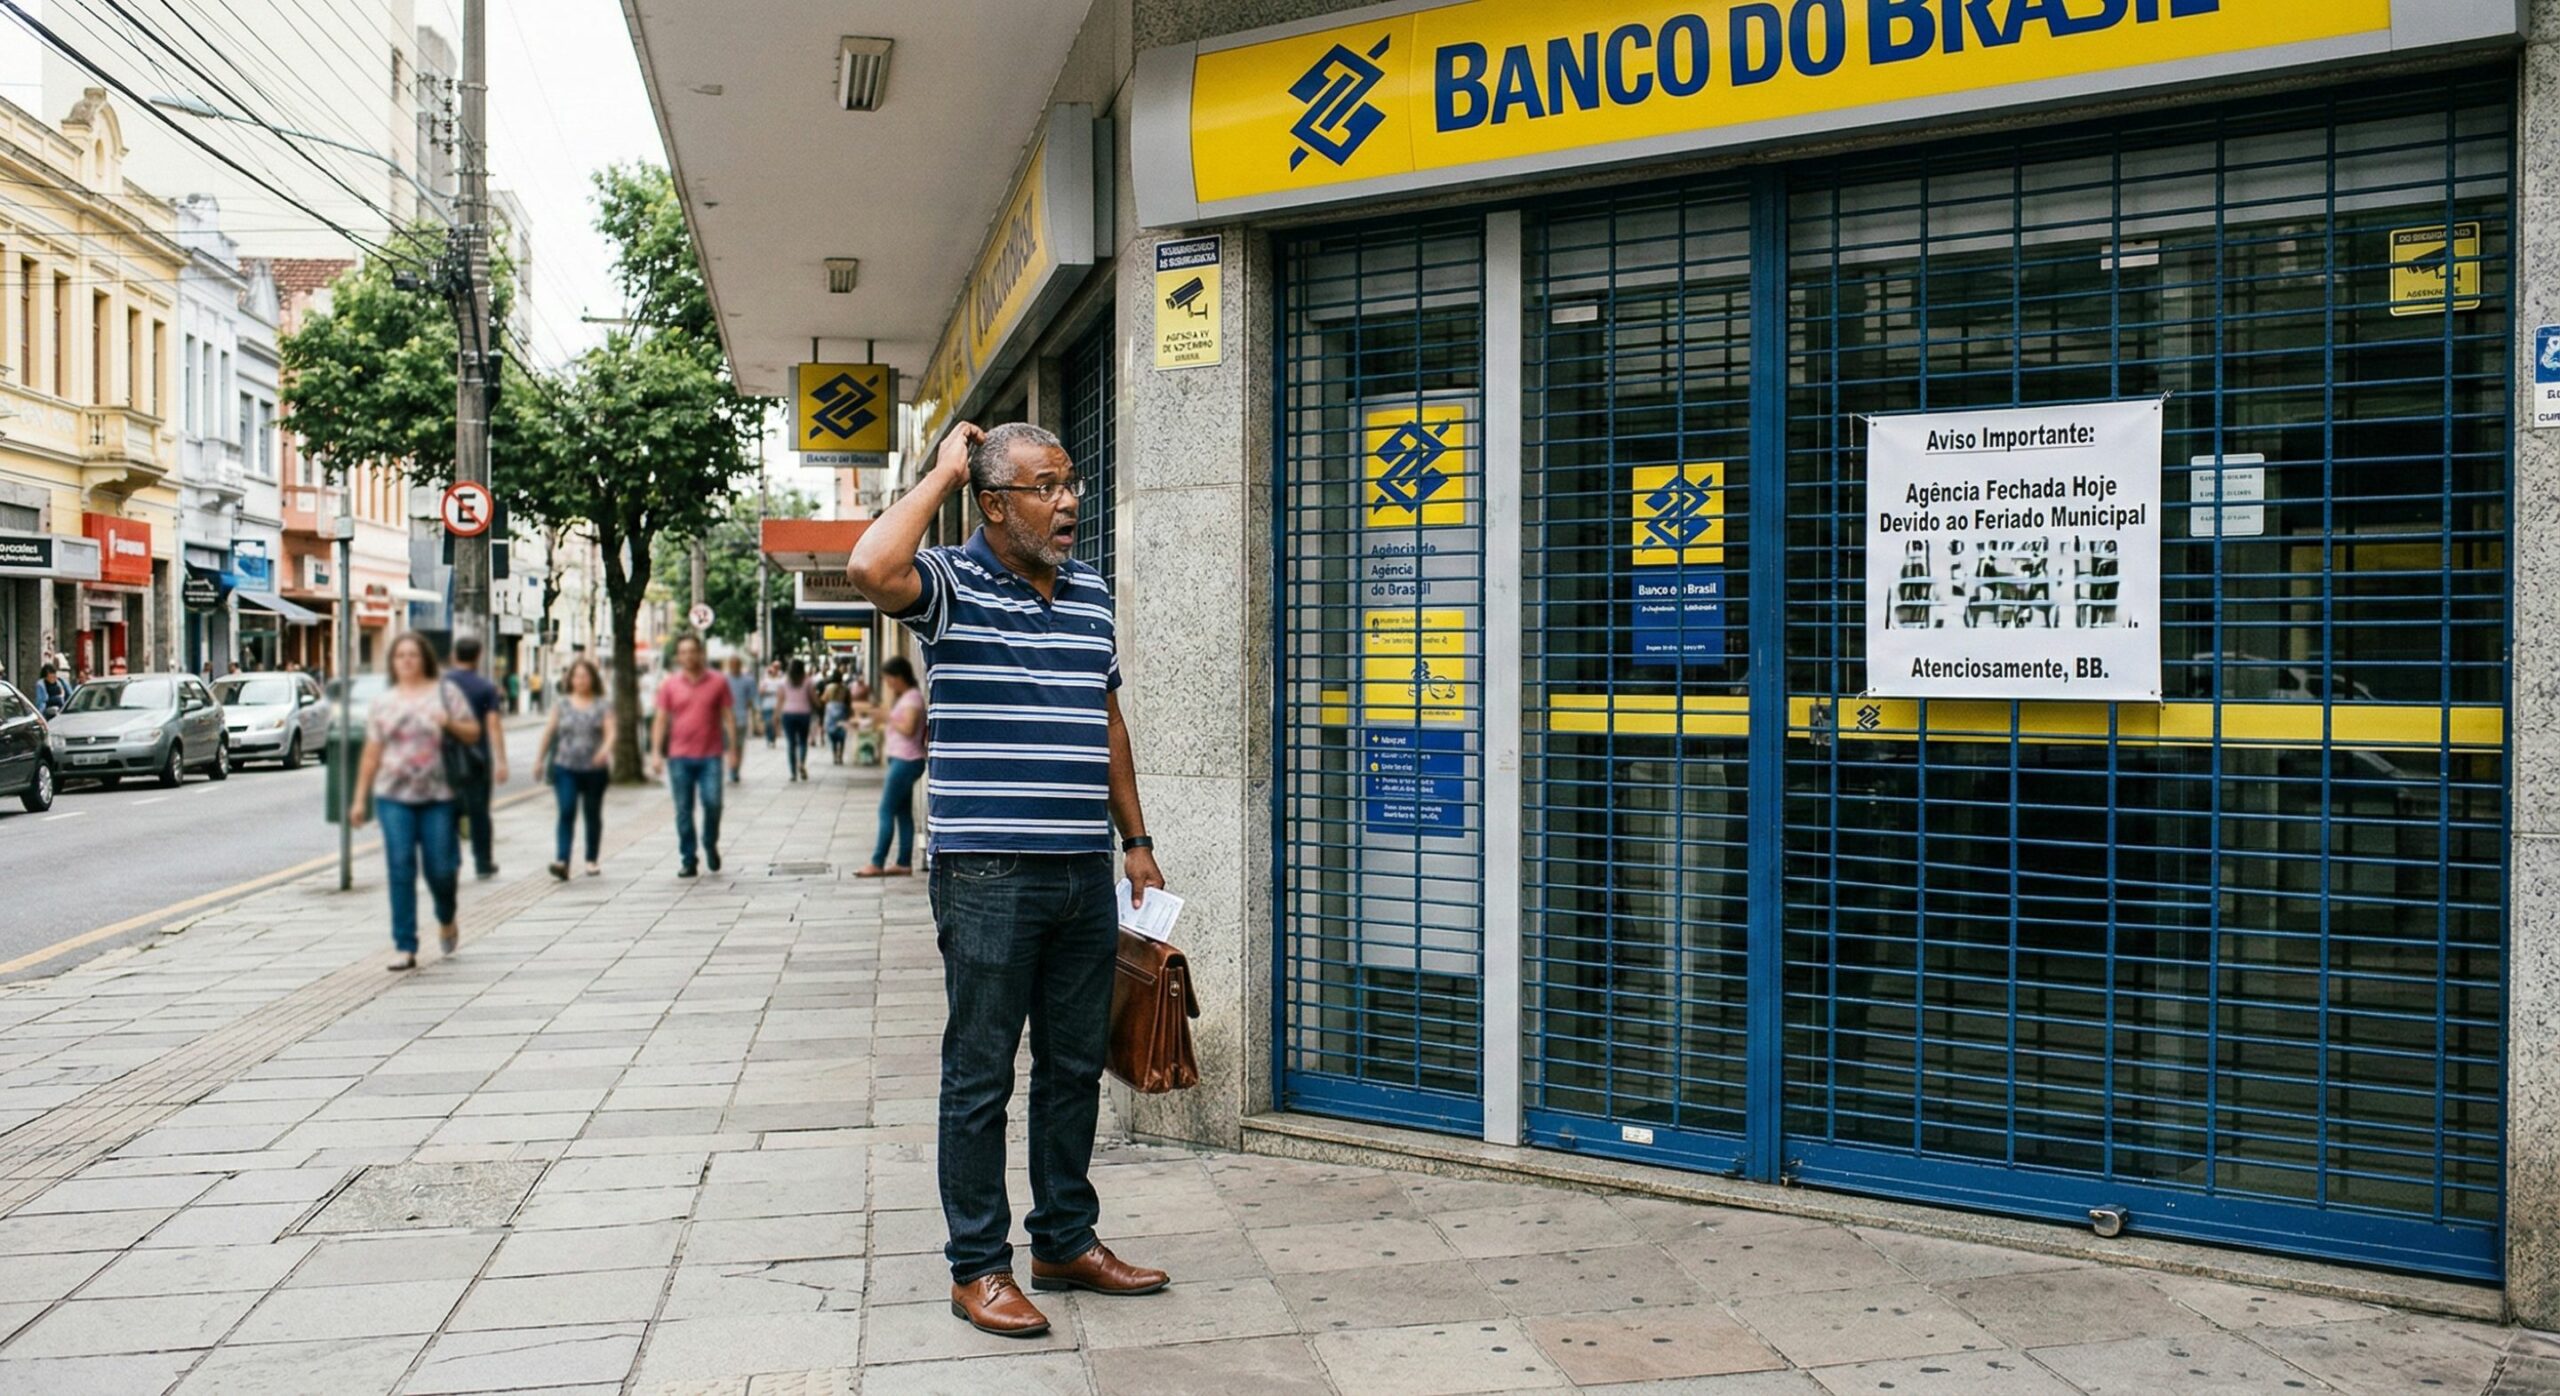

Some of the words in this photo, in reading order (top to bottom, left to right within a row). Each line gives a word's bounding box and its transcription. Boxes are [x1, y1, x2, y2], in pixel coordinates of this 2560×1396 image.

[1434, 13, 1711, 133] BANCO
[1729, 0, 1847, 87] DO
[1926, 429, 1976, 451] Aviso
[1983, 422, 2095, 451] Importante:
[1905, 480, 1980, 508] Agência
[1986, 477, 2066, 500] Fechada
[2073, 474, 2117, 502] Hoje
[457, 493, 476, 523] E
[1880, 511, 1940, 533] Devido
[1946, 515, 1969, 531] ao
[1974, 507, 2045, 530] Feriado
[2051, 502, 2146, 531] Municipal
[1371, 582, 1385, 596] do
[1687, 582, 1717, 595] Brasil
[1911, 657, 2069, 683] Atenciosamente,
[2076, 657, 2110, 679] BB.
